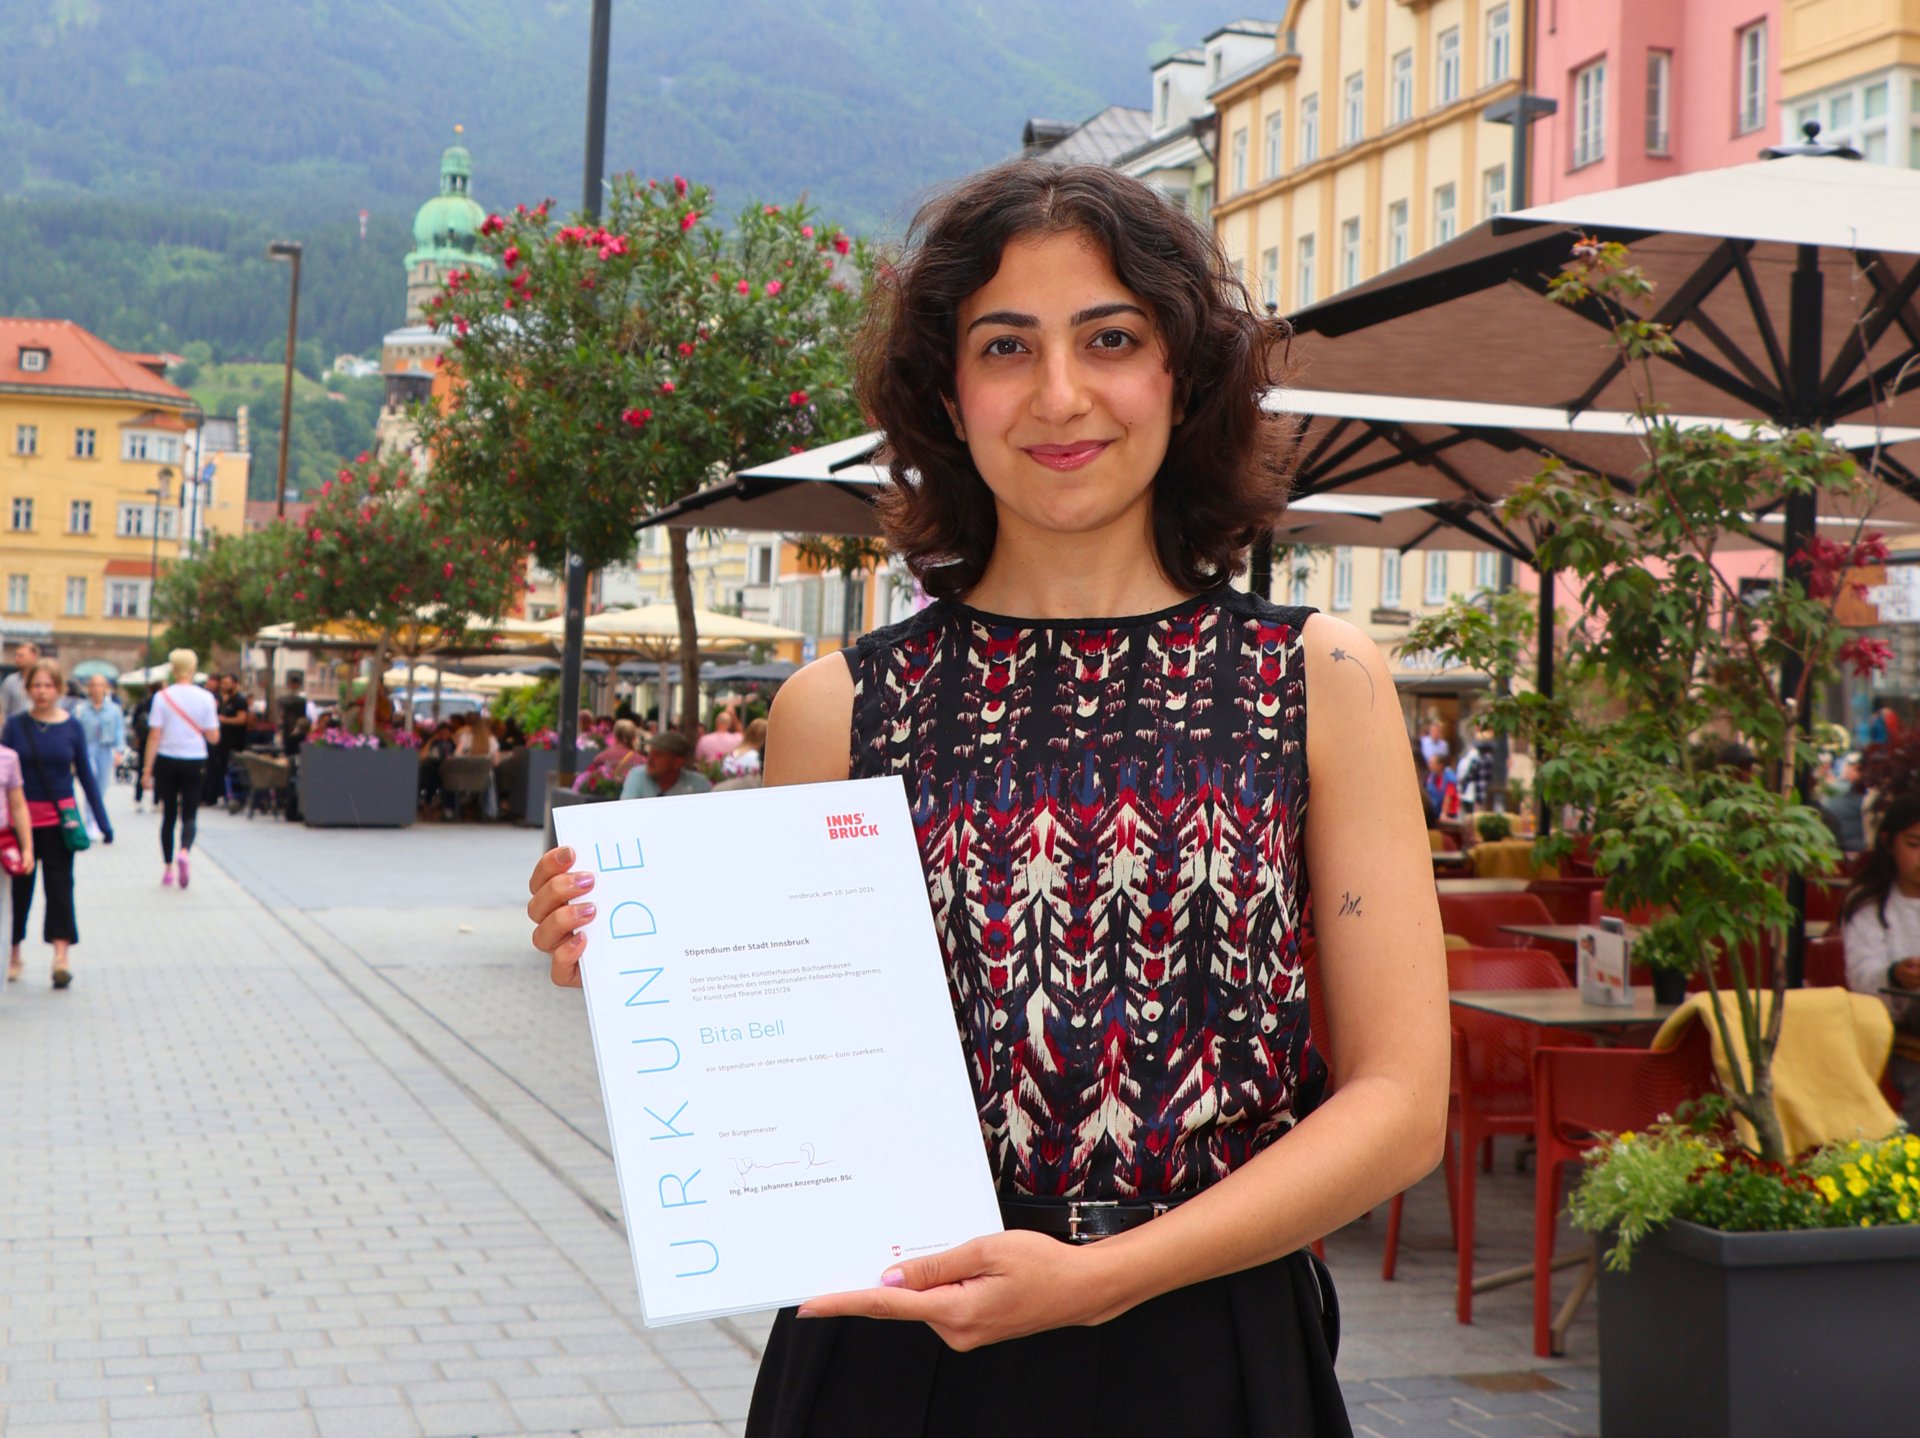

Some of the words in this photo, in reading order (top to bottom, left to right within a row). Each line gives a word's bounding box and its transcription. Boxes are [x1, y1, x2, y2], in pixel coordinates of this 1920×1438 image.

[826, 812, 865, 827] INNS'
[829, 824, 880, 840] BRUCK
[845, 887, 858, 896] Juni
[684, 945, 731, 957] Stipendium
[733, 944, 746, 952] der
[748, 941, 769, 951] Stadt
[771, 937, 810, 948] Innsbruck
[689, 975, 705, 984] Über
[706, 972, 738, 983] Vorschlag
[739, 972, 751, 980] des
[752, 968, 800, 978] Künstlerhauses
[691, 985, 706, 993] wird
[717, 981, 744, 990] Rahmen
[746, 980, 757, 988] des
[692, 995, 702, 1003] für
[704, 993, 722, 1001] Kunst
[724, 991, 737, 999] und
[738, 988, 763, 997] Theorie
[764, 986, 791, 995] 2025/26
[700, 1026, 743, 1045] Bita
[748, 1019, 785, 1039] Bell
[596, 838, 719, 1278] URKUNDE
[706, 1065, 717, 1073] ein
[718, 1062, 756, 1073] Stipendium
[835, 1051, 850, 1059] Euro
[718, 1131, 730, 1139] Der
[731, 1125, 778, 1138] Bürgermeister
[729, 1188, 742, 1196] Ing.
[744, 1187, 760, 1195] Mag.
[761, 1182, 793, 1193] Johannes
[794, 1176, 839, 1187] Anzengruber,
[840, 1174, 853, 1183] BSc
